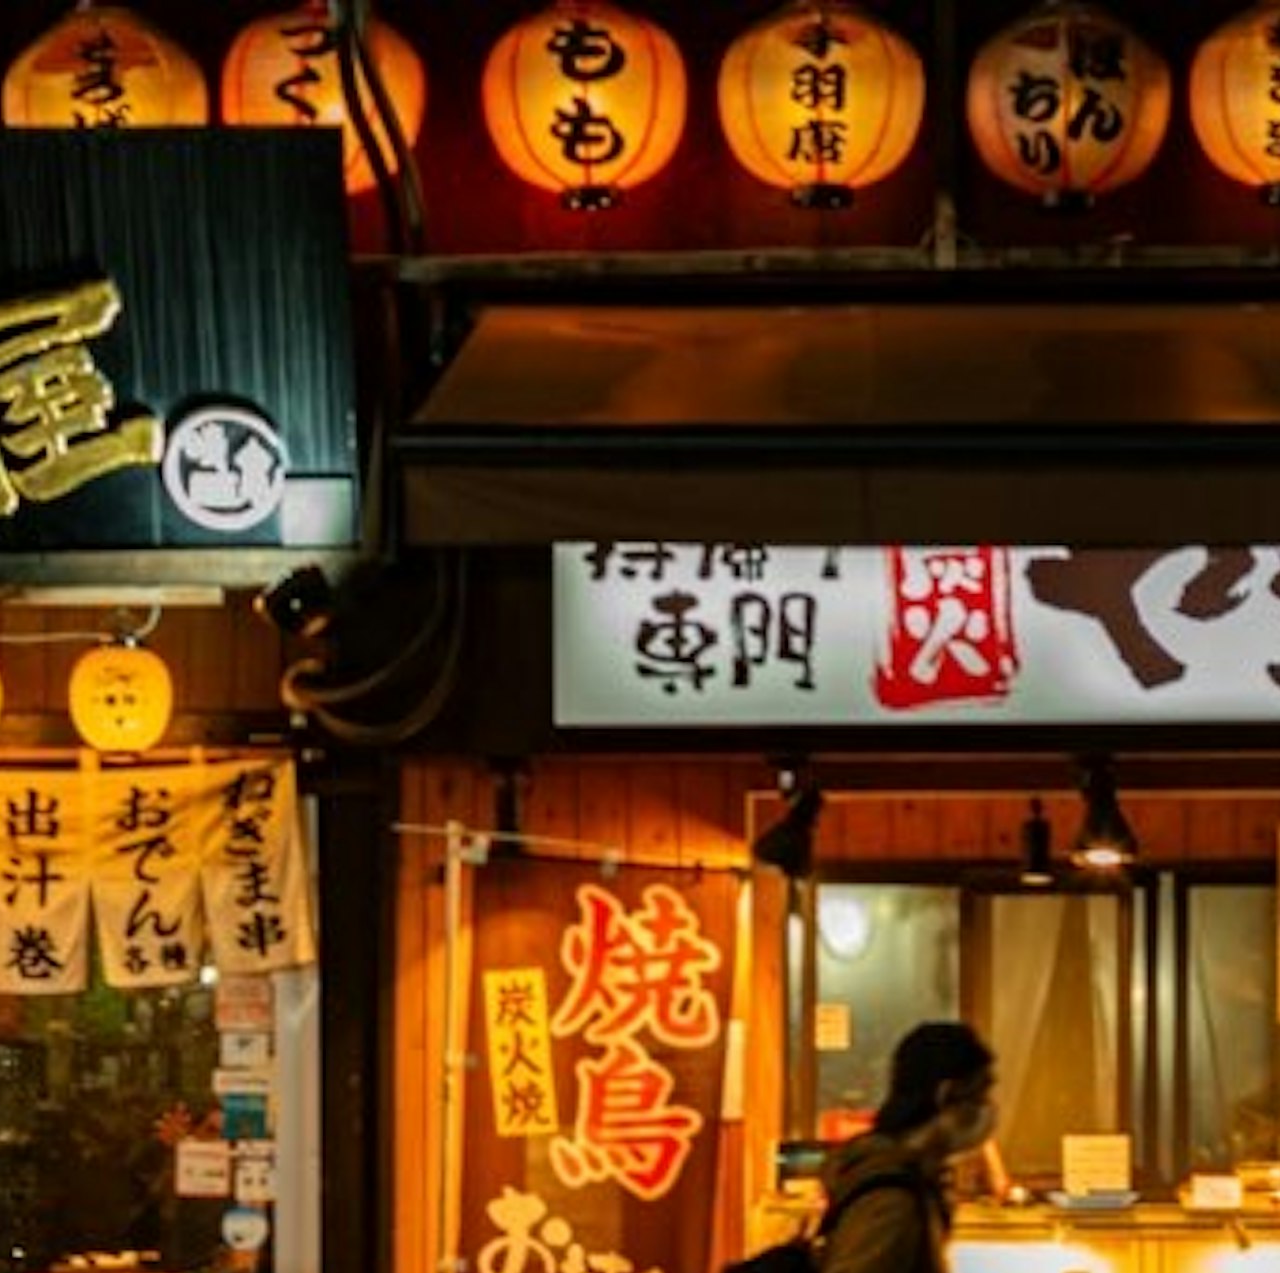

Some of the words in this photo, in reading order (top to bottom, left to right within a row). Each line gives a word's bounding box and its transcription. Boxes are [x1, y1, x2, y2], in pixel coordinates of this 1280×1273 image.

[548, 18, 626, 165] もも
[635, 590, 818, 692] 専門
[4, 788, 64, 983] 出汁巻
[116, 786, 181, 940] おでん
[550, 883, 721, 1200] 焼鳥
